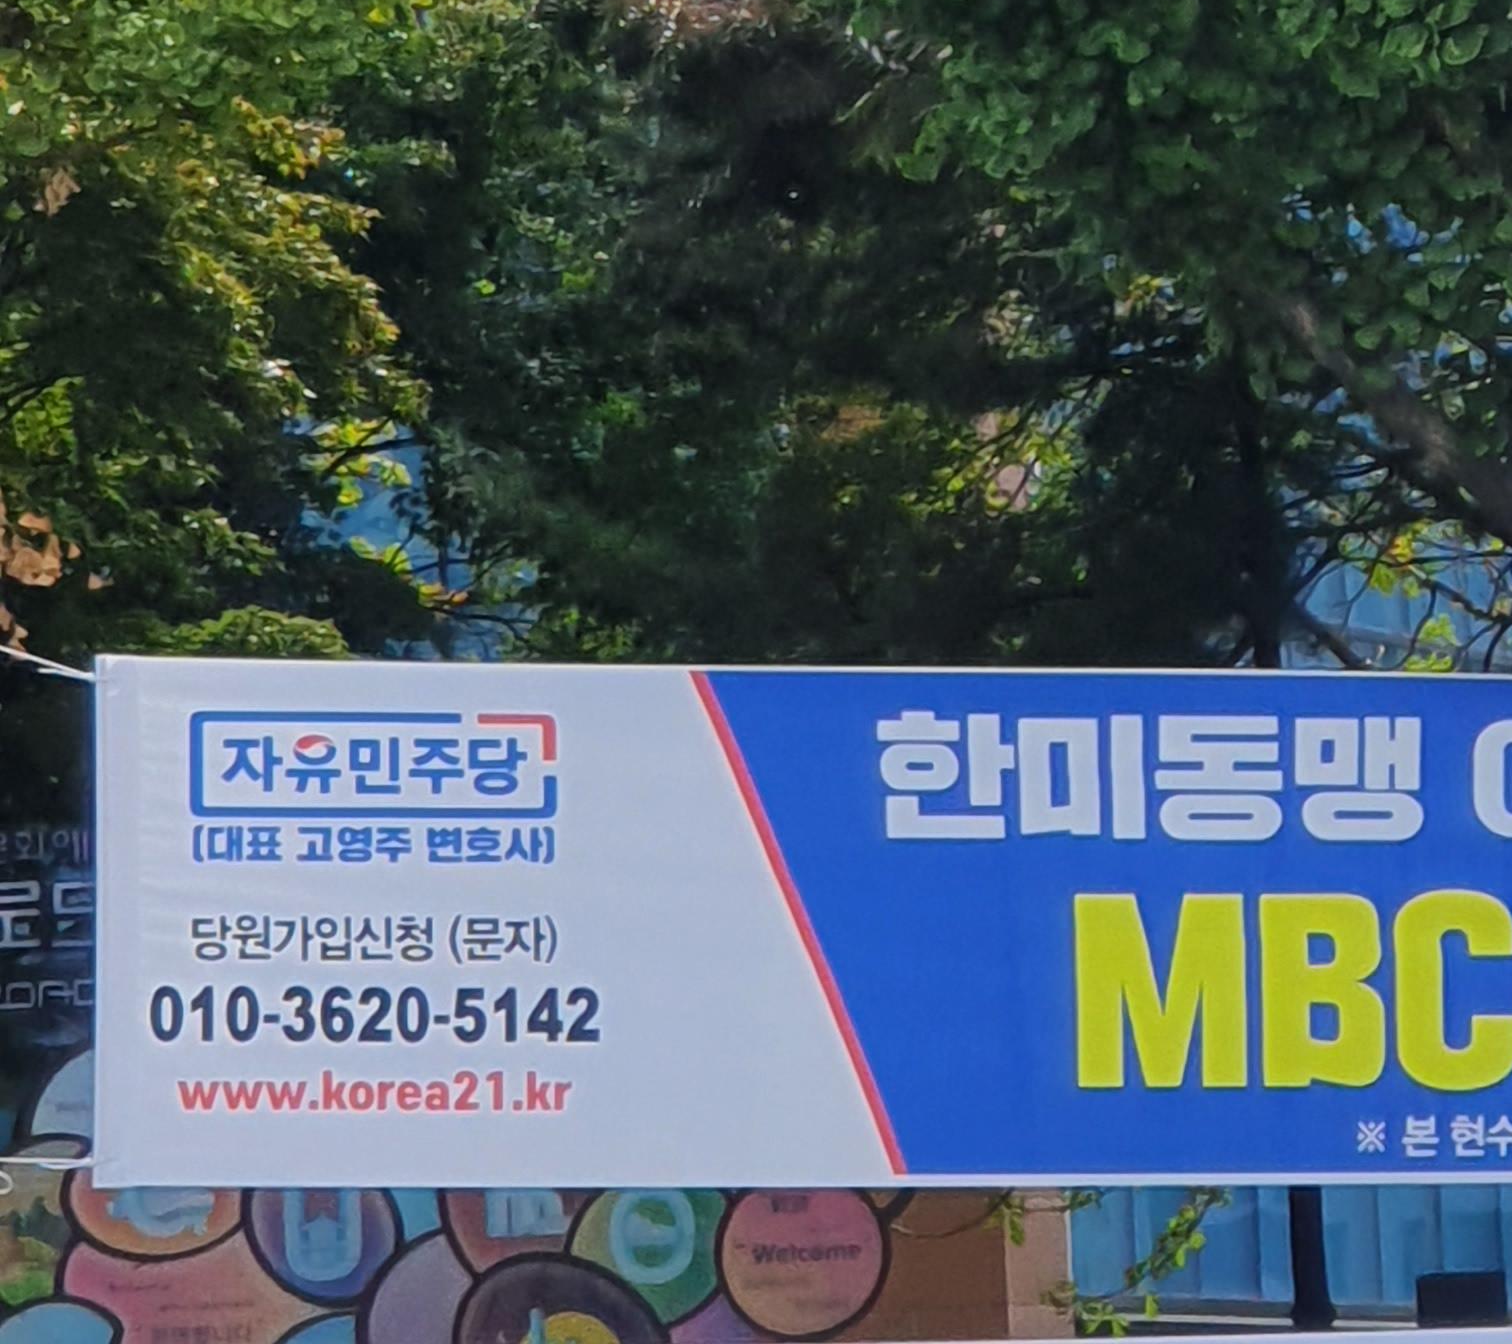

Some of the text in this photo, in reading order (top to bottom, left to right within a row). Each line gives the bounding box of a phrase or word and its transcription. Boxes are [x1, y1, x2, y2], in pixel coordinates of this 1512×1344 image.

[220, 733, 528, 796] 자유민주당
[876, 709, 1425, 842] 한미동맹
[296, 826, 412, 863] 고영주
[191, 914, 559, 963] 당원가입신청 (문자)
[150, 985, 601, 1043] 010-3620-5142
[177, 1070, 573, 1112] www.korea21.kr
[1401, 1114, 1440, 1157] 본
